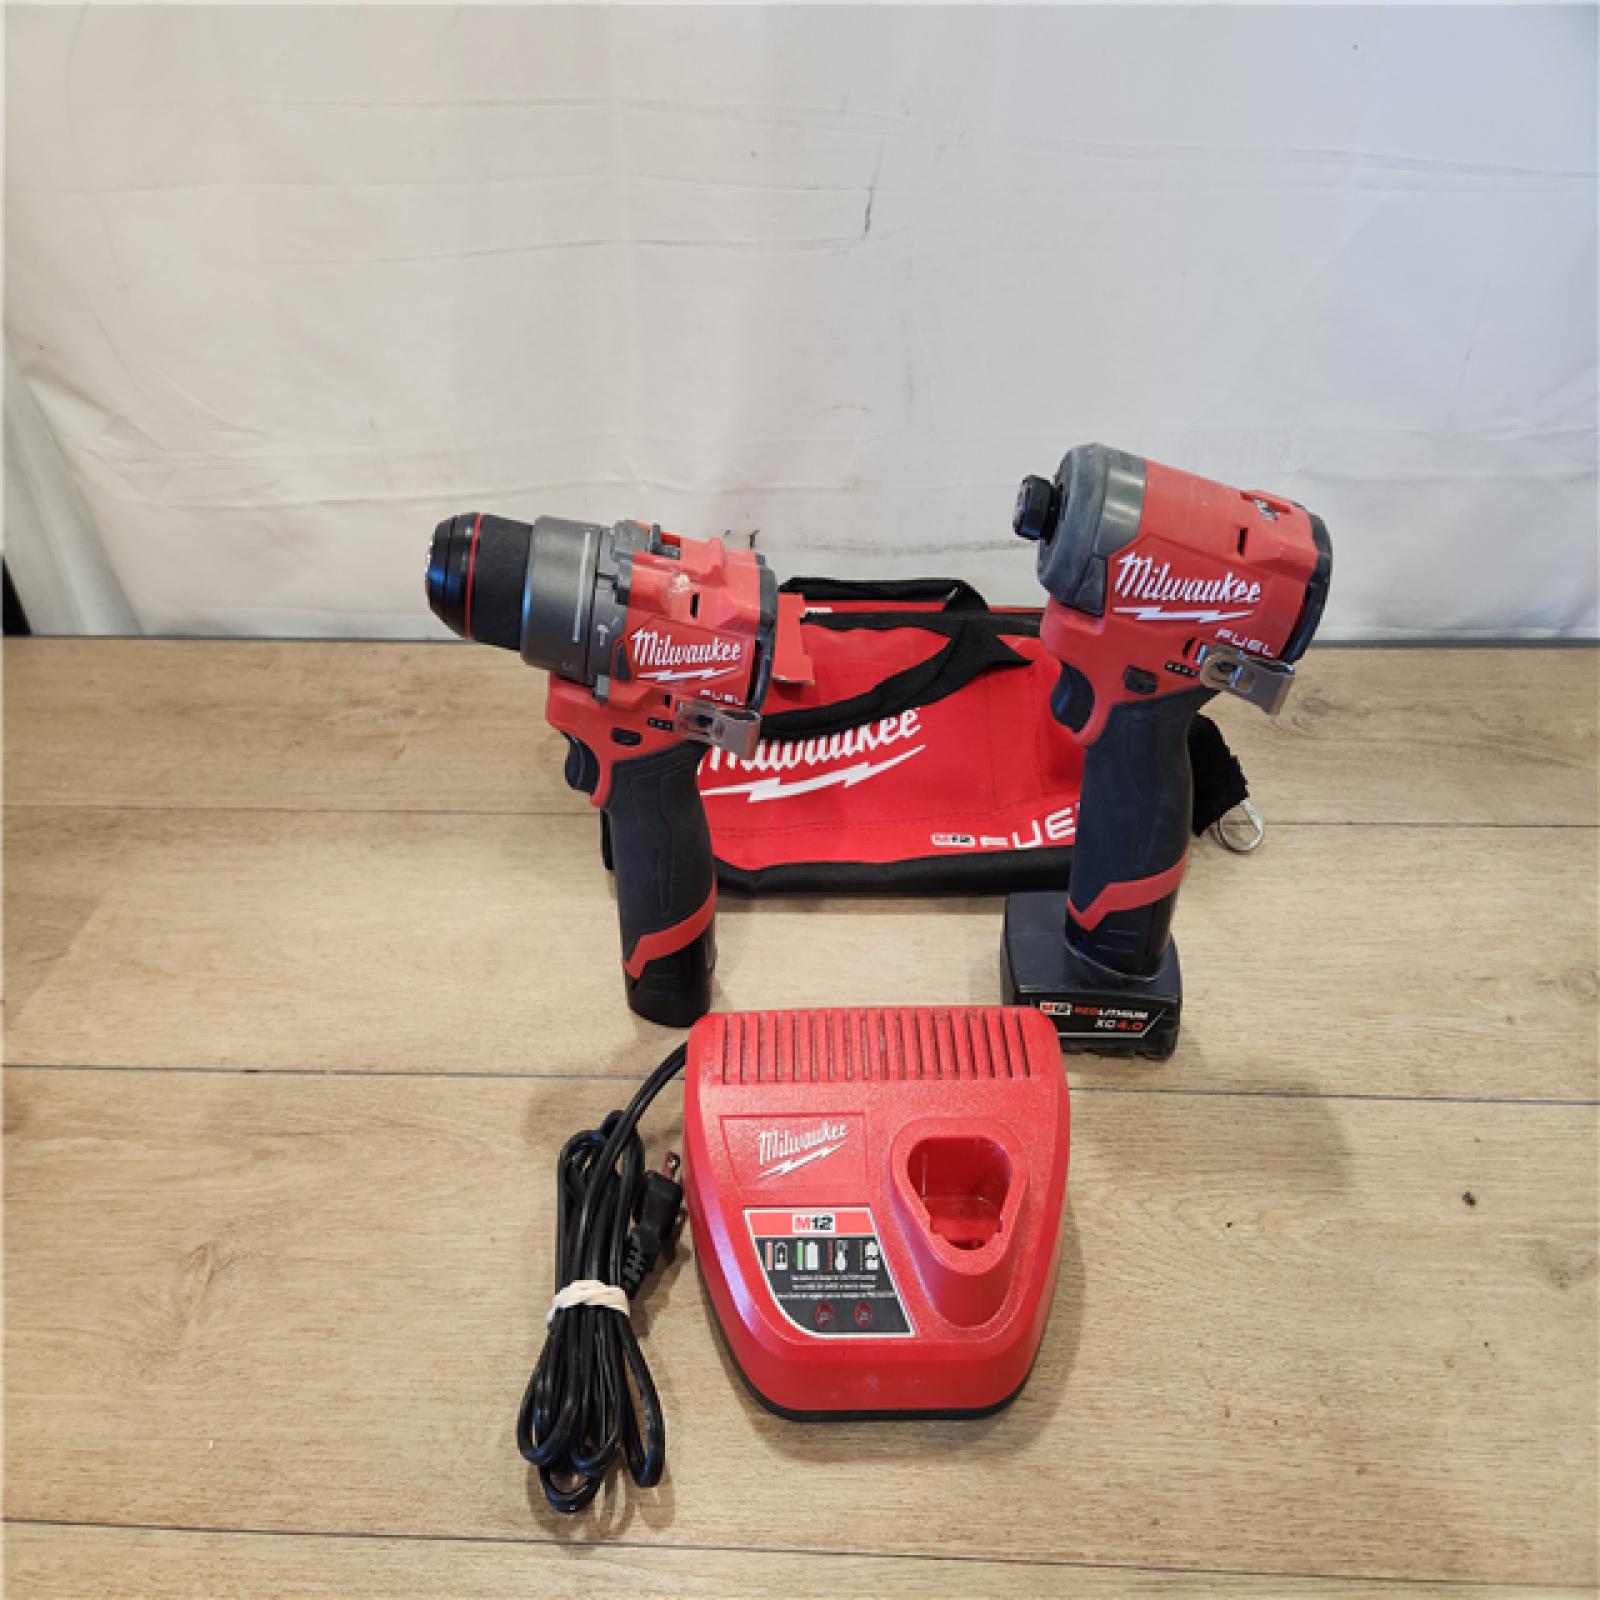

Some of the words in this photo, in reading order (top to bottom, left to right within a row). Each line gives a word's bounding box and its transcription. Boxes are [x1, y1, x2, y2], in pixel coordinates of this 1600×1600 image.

[1115, 552, 1261, 603] Milwaukee
[631, 629, 741, 666] Milwaukee
[1215, 629, 1274, 658] FUEL
[979, 801, 1081, 849] FUE
[758, 1120, 848, 1166] Milwaukee
[793, 1216, 833, 1231] M12
